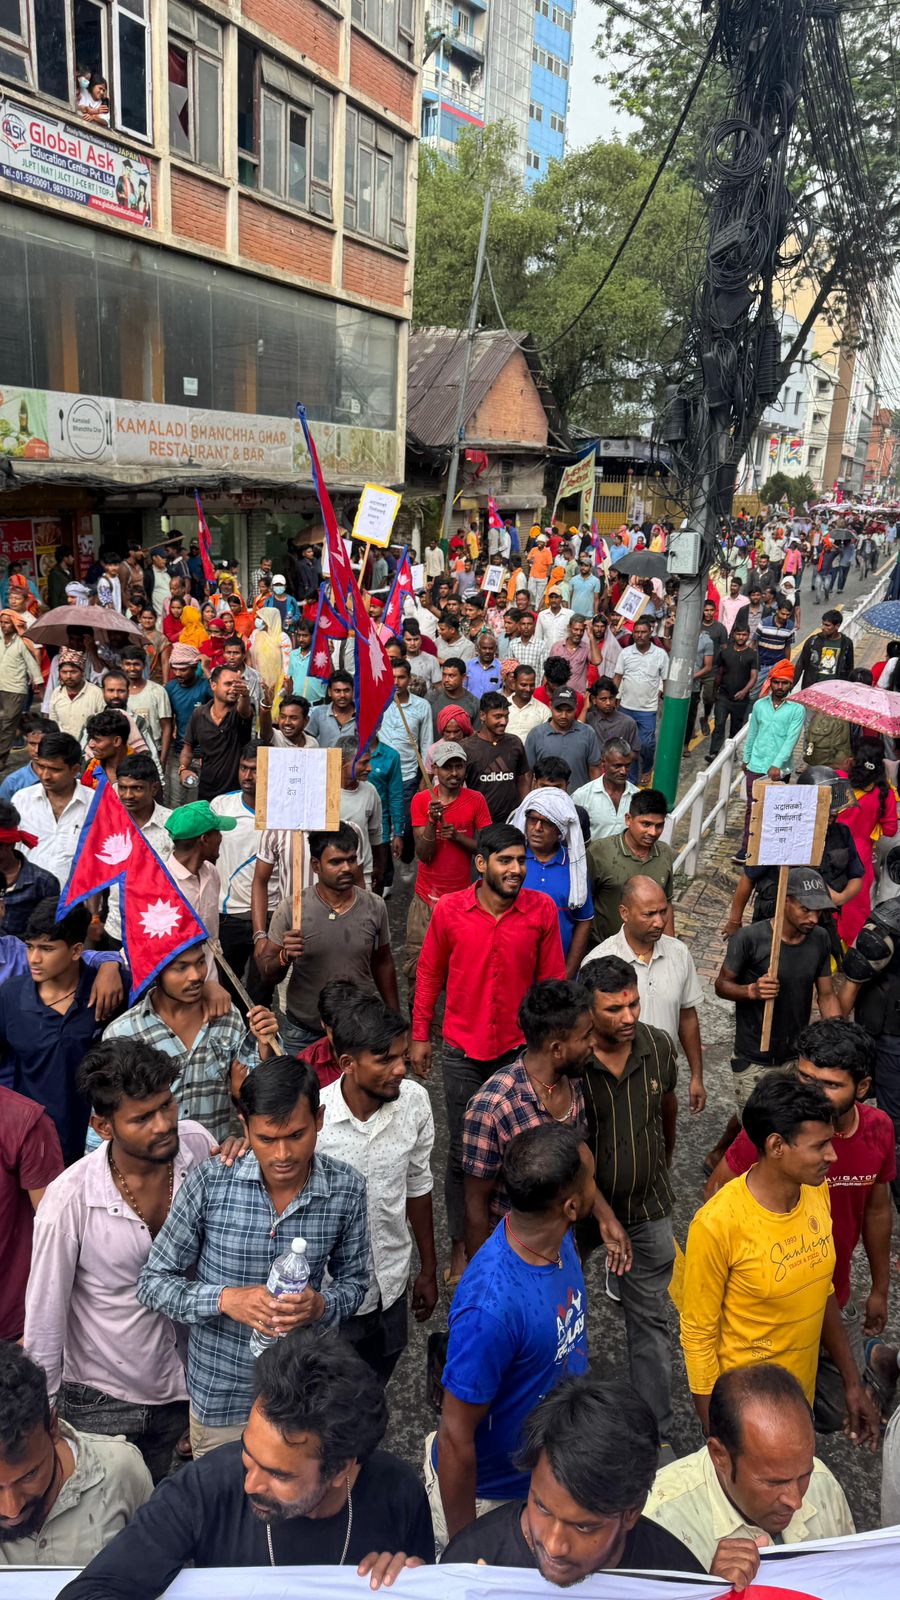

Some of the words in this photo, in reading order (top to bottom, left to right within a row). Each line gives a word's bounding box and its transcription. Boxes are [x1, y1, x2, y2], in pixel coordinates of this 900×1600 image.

[30, 121, 82, 159] Global
[86, 144, 115, 173] Ask
[118, 147, 139, 161] JAPAN
[22, 158, 36, 171] JLPT
[41, 165, 53, 176] NAT
[31, 146, 66, 168] Education
[68, 160, 89, 176] Center
[116, 416, 187, 439] KAMALADI
[191, 424, 255, 443] BHANCHHA
[258, 430, 287, 445] GHAR
[149, 440, 229, 460] RESTAURANT
[233, 449, 239, 460] &
[243, 448, 264, 461] BAR
[480, 771, 514, 782] adidas
